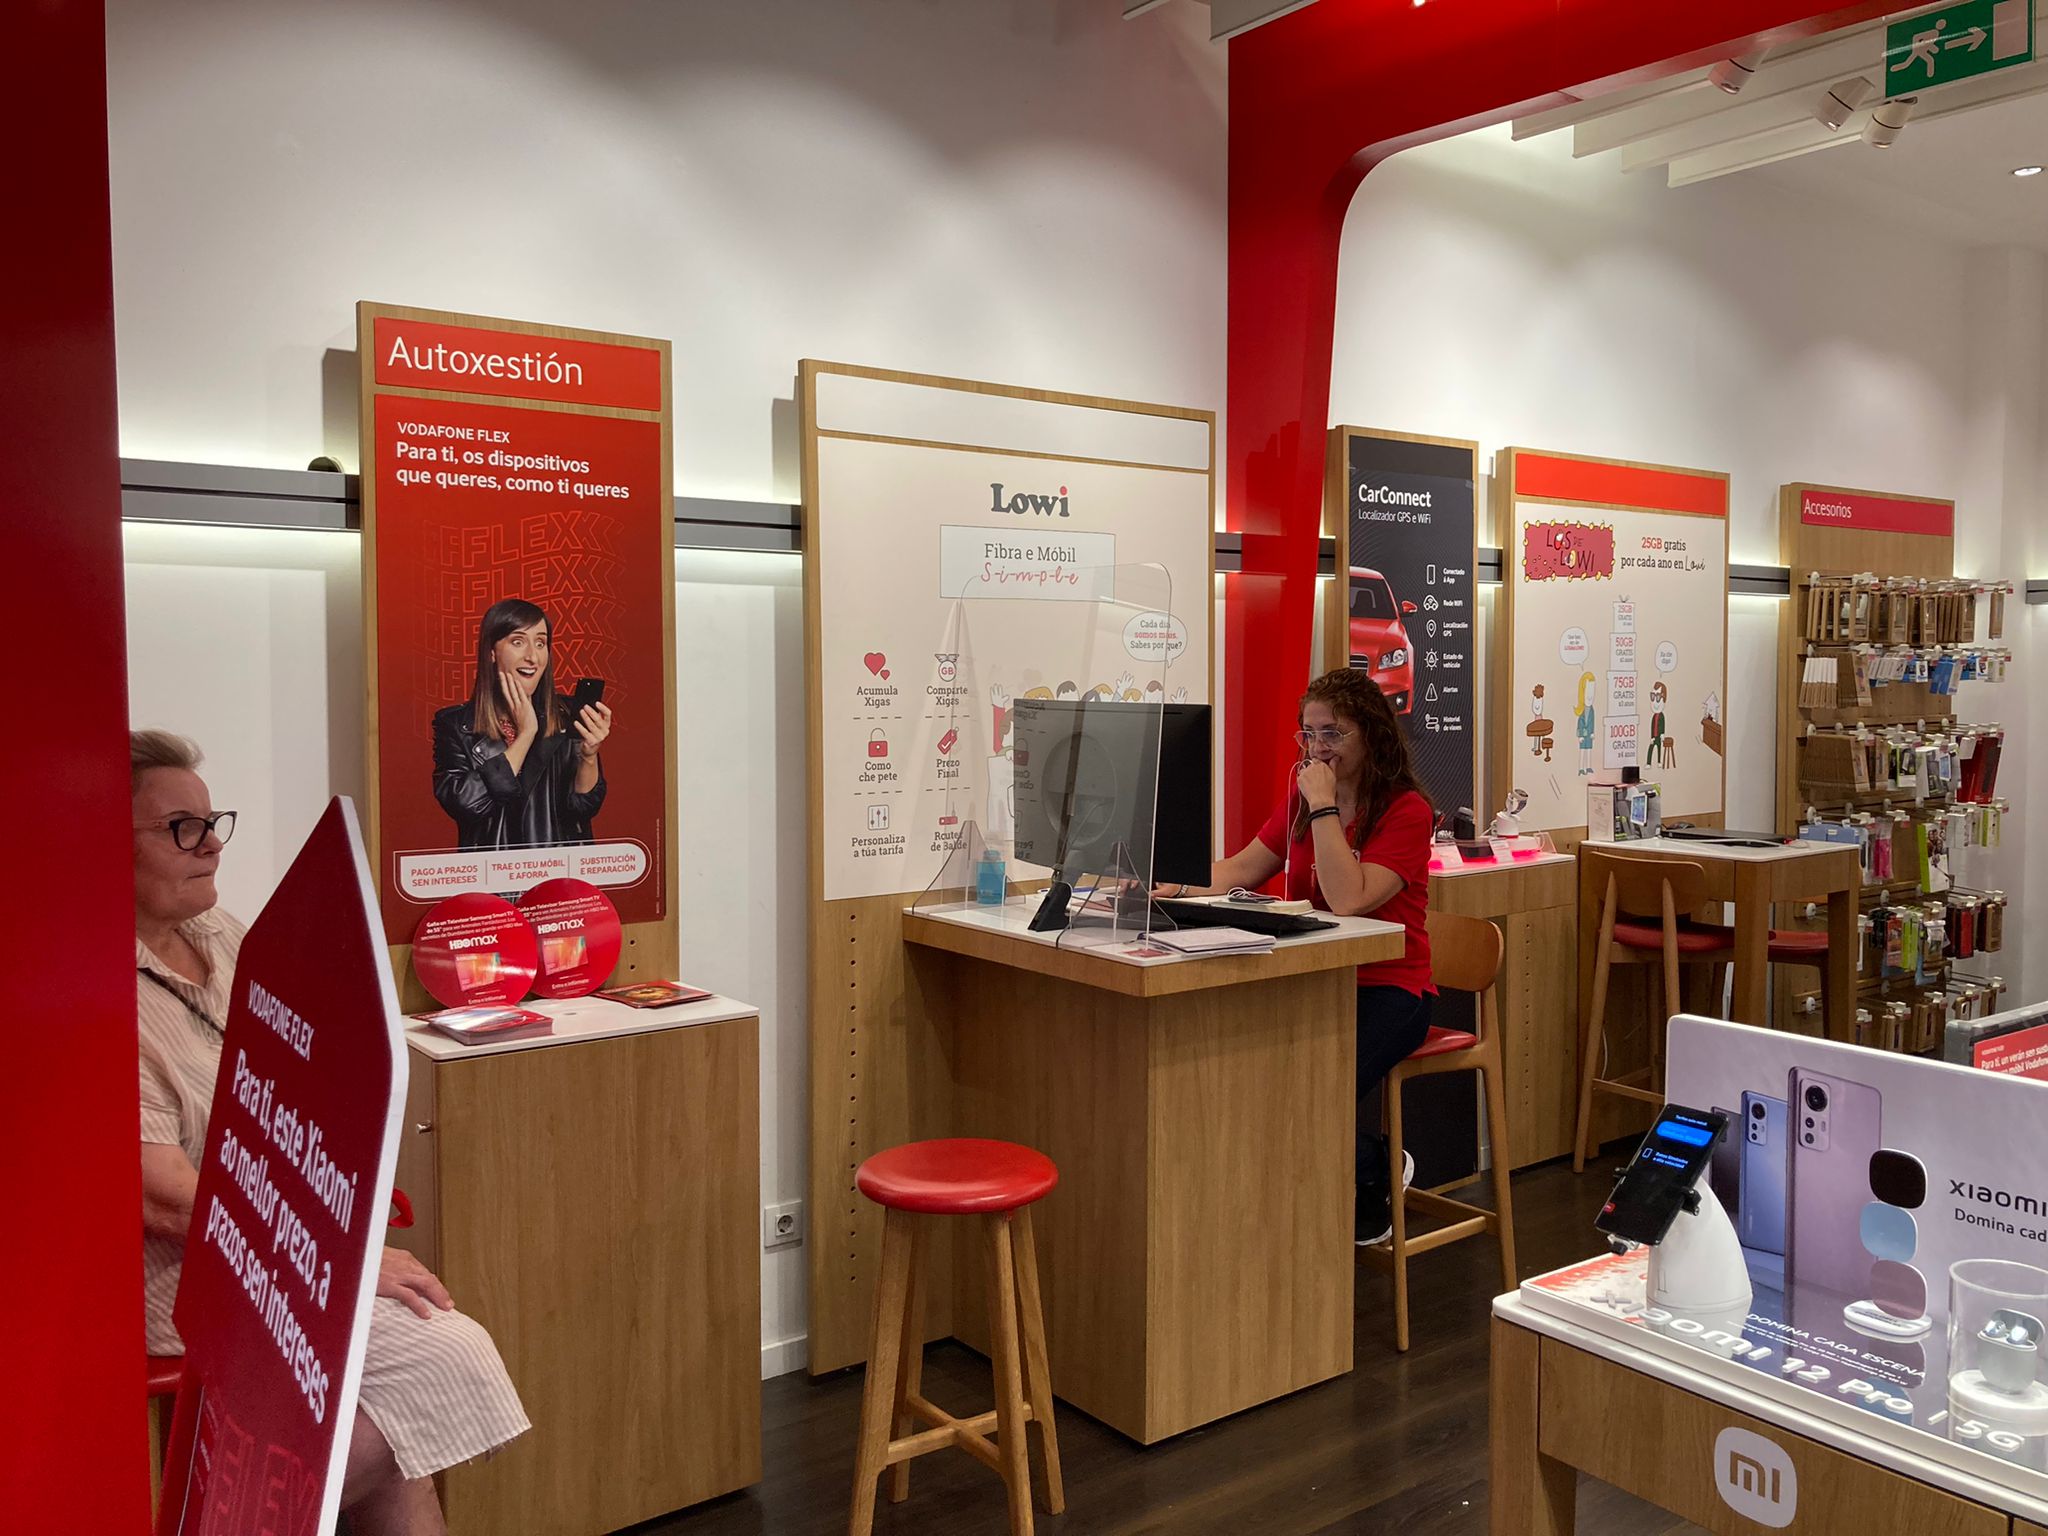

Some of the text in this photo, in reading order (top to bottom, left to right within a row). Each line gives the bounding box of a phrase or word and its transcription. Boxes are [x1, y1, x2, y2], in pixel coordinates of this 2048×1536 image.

[388, 336, 583, 385] Autoxestión
[397, 422, 510, 444] VODAFONE FLEX
[396, 442, 590, 474] Para ti, os dispositivos
[396, 467, 630, 500] que queres, como ti queres
[990, 483, 1070, 517] Lowi
[1359, 484, 1431, 507] CarConnect
[1804, 498, 1852, 518] Accesorios
[1359, 508, 1431, 524] Localizador GPS e WiFi
[1642, 537, 1686, 552] 25GB gratis
[984, 543, 1076, 563] Fibra e Móbil
[1621, 556, 1635, 569] por
[1637, 555, 1656, 568] cada
[1658, 559, 1672, 569] ano
[1674, 561, 1684, 569] en
[1618, 605, 1632, 613] 25GB
[1140, 620, 1157, 628] Cada
[1130, 640, 1151, 649] Sabes
[1152, 642, 1164, 650] por
[1616, 637, 1633, 647] 50GB
[941, 667, 954, 676] GB
[1614, 677, 1634, 688] 75GB
[857, 686, 898, 696] Acumula
[1614, 691, 1634, 699] GRATIS
[864, 697, 890, 708] Xigas
[1610, 725, 1635, 738] 100GB
[1612, 740, 1635, 750] GRATIS
[865, 762, 891, 771] Como
[859, 773, 898, 783] che pete
[852, 834, 906, 847] Personaliza
[931, 842, 942, 852] de
[862, 847, 877, 857] túa
[879, 846, 904, 855] tarifa
[492, 863, 512, 871] TRAE
[515, 862, 521, 870] O
[540, 858, 566, 868] MÓBIL
[580, 854, 636, 865] SUBSTITUCIÓN
[411, 865, 478, 877] PAGO A PRAZOS
[516, 870, 548, 880] AFORRA
[580, 864, 636, 875] E REPARACIÓN
[412, 875, 477, 887] SEN INTERESES
[248, 980, 314, 1061] VODAFONE FLEX
[2001, 1056, 2008, 1064] un
[2009, 1050, 2025, 1062] verán
[2026, 1049, 2035, 1058] sen
[232, 1048, 358, 1233] Para ti, este Xiaomi
[220, 1128, 332, 1311] ao mellor prezo, a
[1955, 1208, 2047, 1242] Domina cad
[205, 1195, 330, 1424] prazos sen intereses
[1746, 1313, 1926, 1378] DOMINA CADA ESCENA
[1782, 1358, 1830, 1384] 12
[1838, 1378, 1914, 1414] Pro
[1956, 1419, 2025, 1452] 5G
